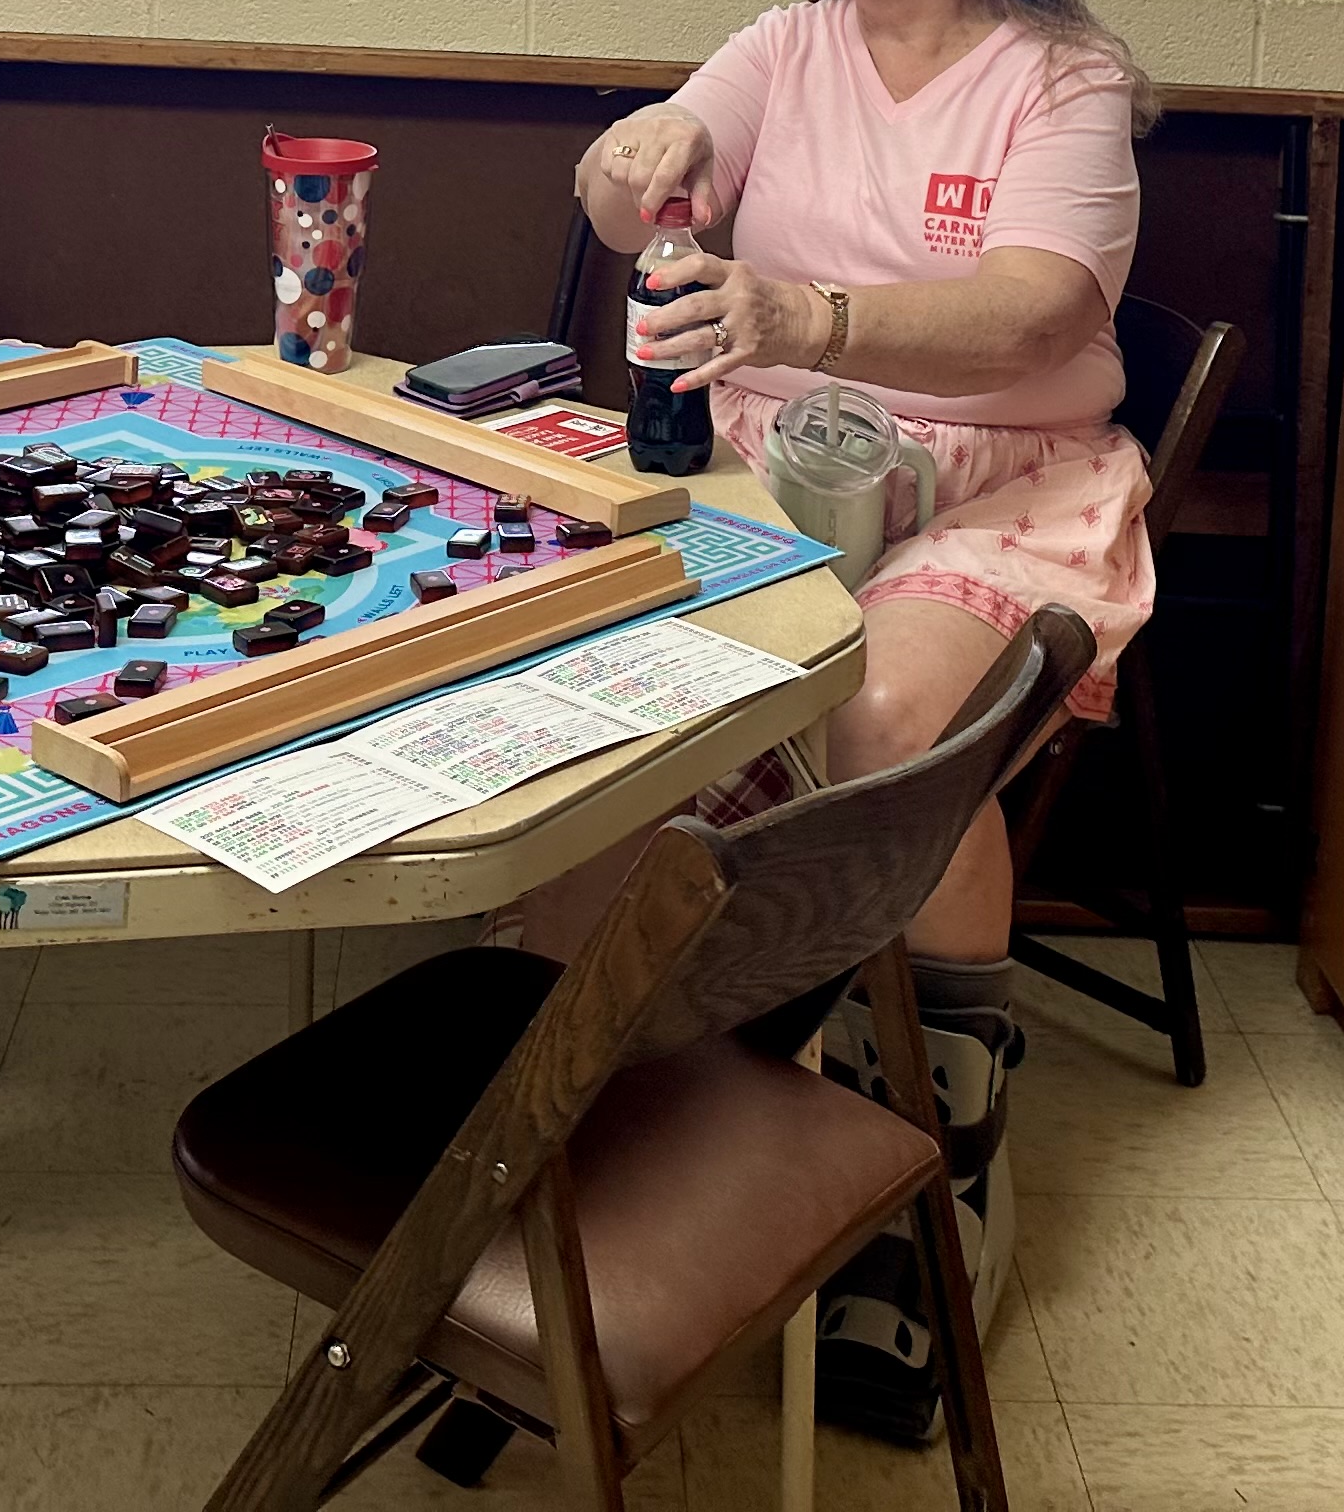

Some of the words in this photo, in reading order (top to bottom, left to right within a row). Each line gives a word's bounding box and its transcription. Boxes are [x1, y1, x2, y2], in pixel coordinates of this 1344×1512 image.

[936, 183, 967, 209] W
[924, 232, 965, 247] WATER
[360, 598, 395, 619] WALLS
[183, 646, 229, 658] PLAY
